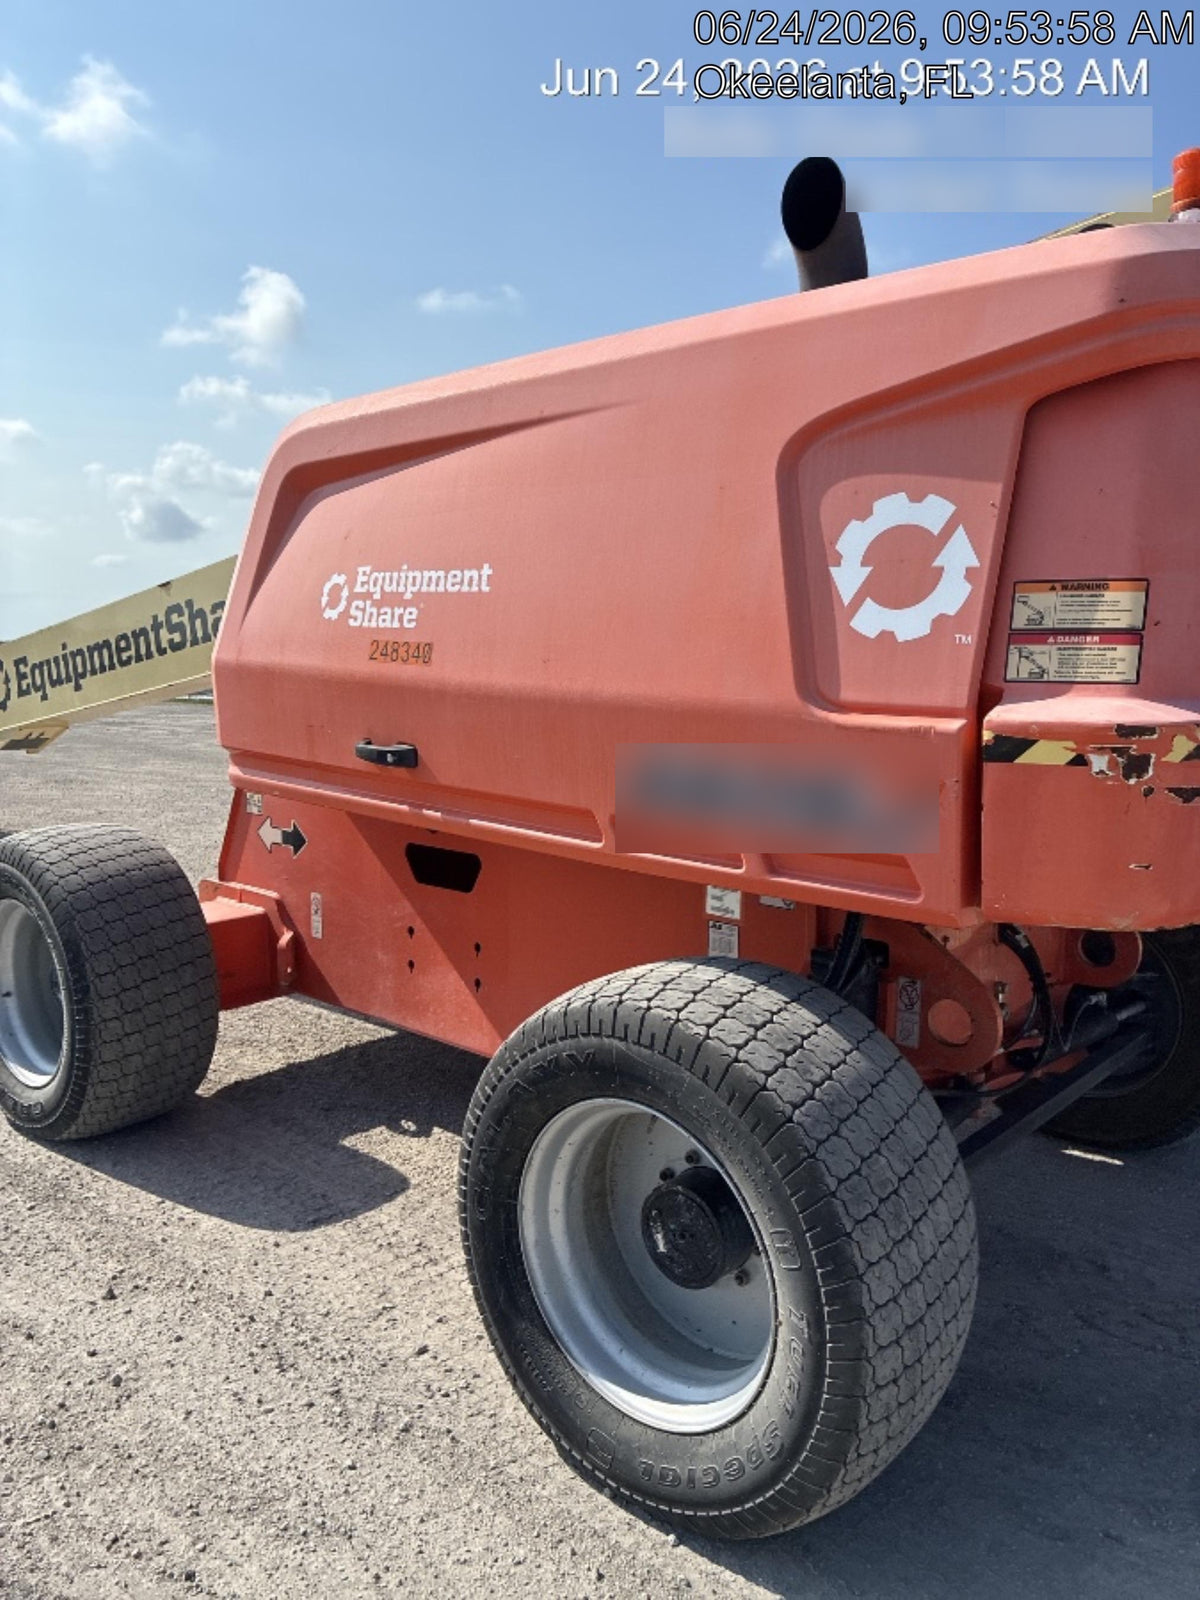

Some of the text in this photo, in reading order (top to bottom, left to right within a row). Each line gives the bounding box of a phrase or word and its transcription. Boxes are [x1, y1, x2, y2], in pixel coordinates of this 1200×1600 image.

[353, 563, 493, 600] Equipment
[1060, 582, 1110, 592] WARNING
[348, 599, 419, 629] Share
[954, 633, 972, 645] TM
[1056, 634, 1100, 644] DANGER
[369, 639, 434, 665] 248340
